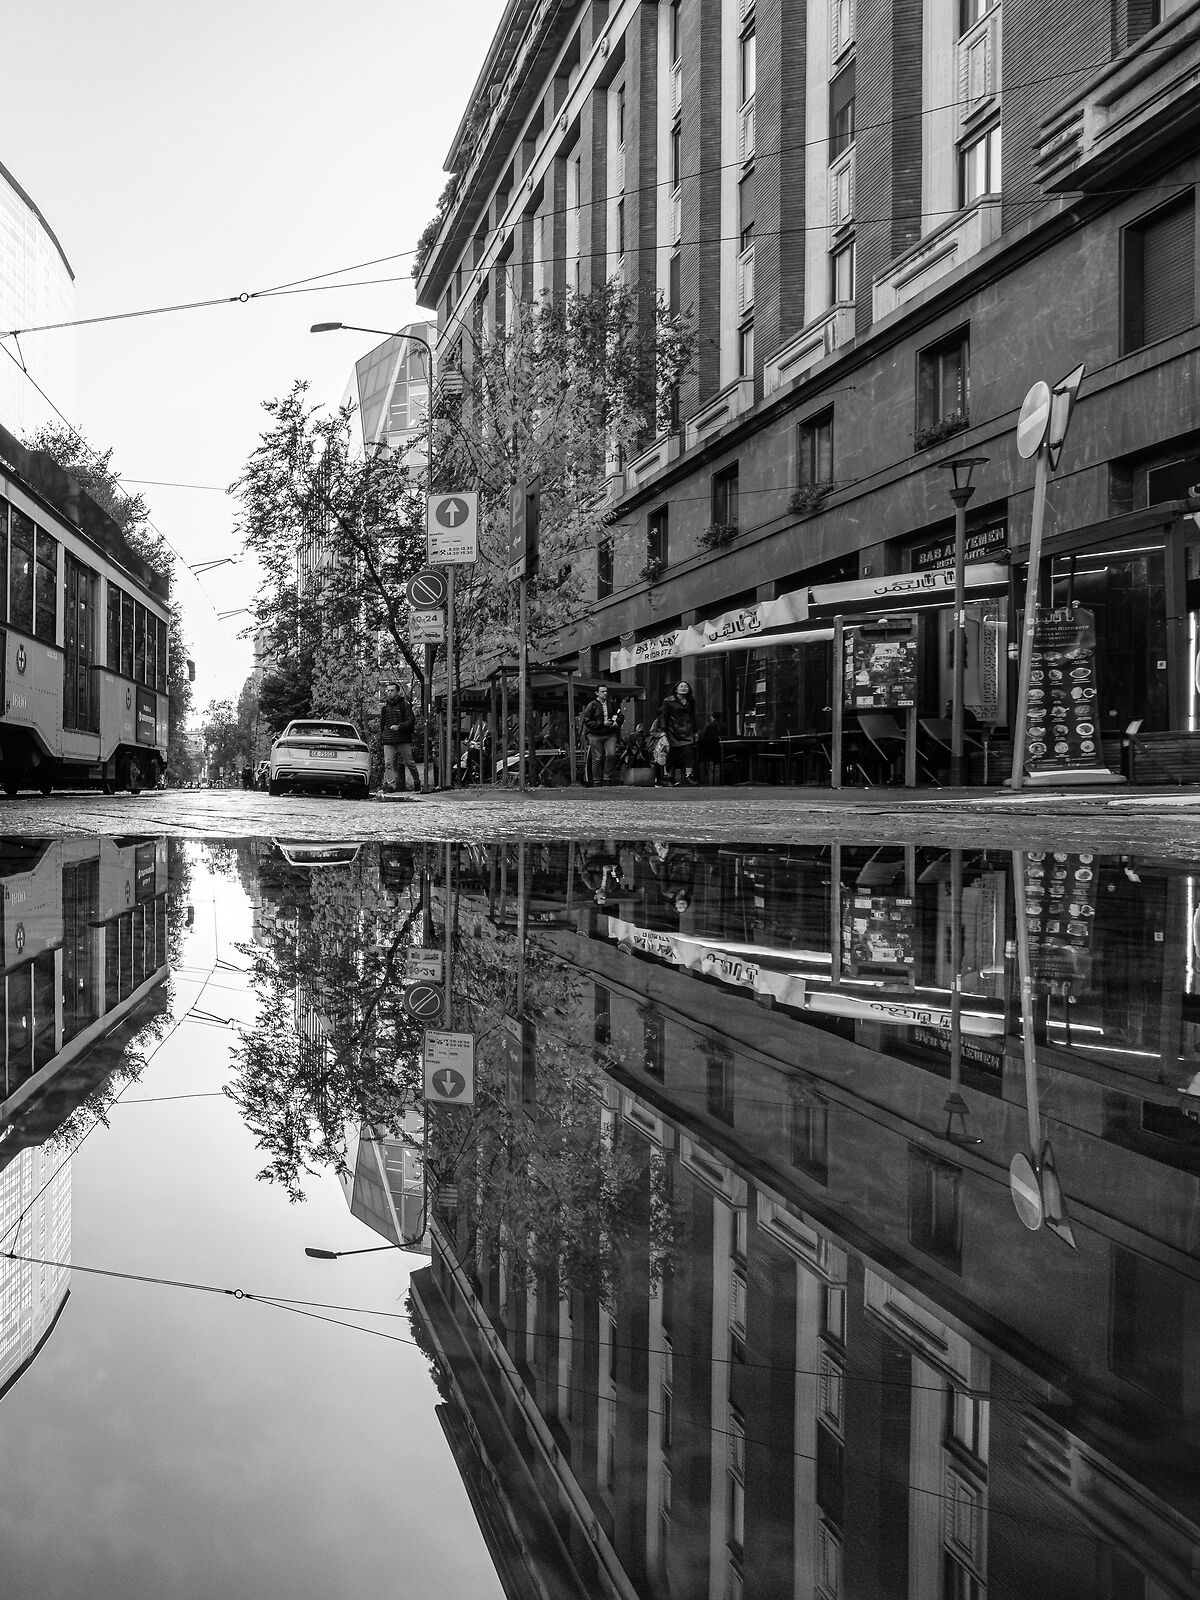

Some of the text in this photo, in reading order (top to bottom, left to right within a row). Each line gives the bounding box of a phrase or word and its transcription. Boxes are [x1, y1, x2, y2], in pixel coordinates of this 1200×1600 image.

[919, 548, 941, 564] BAB
[964, 527, 1004, 551] YEMEN
[12, 692, 27, 709] 1600
